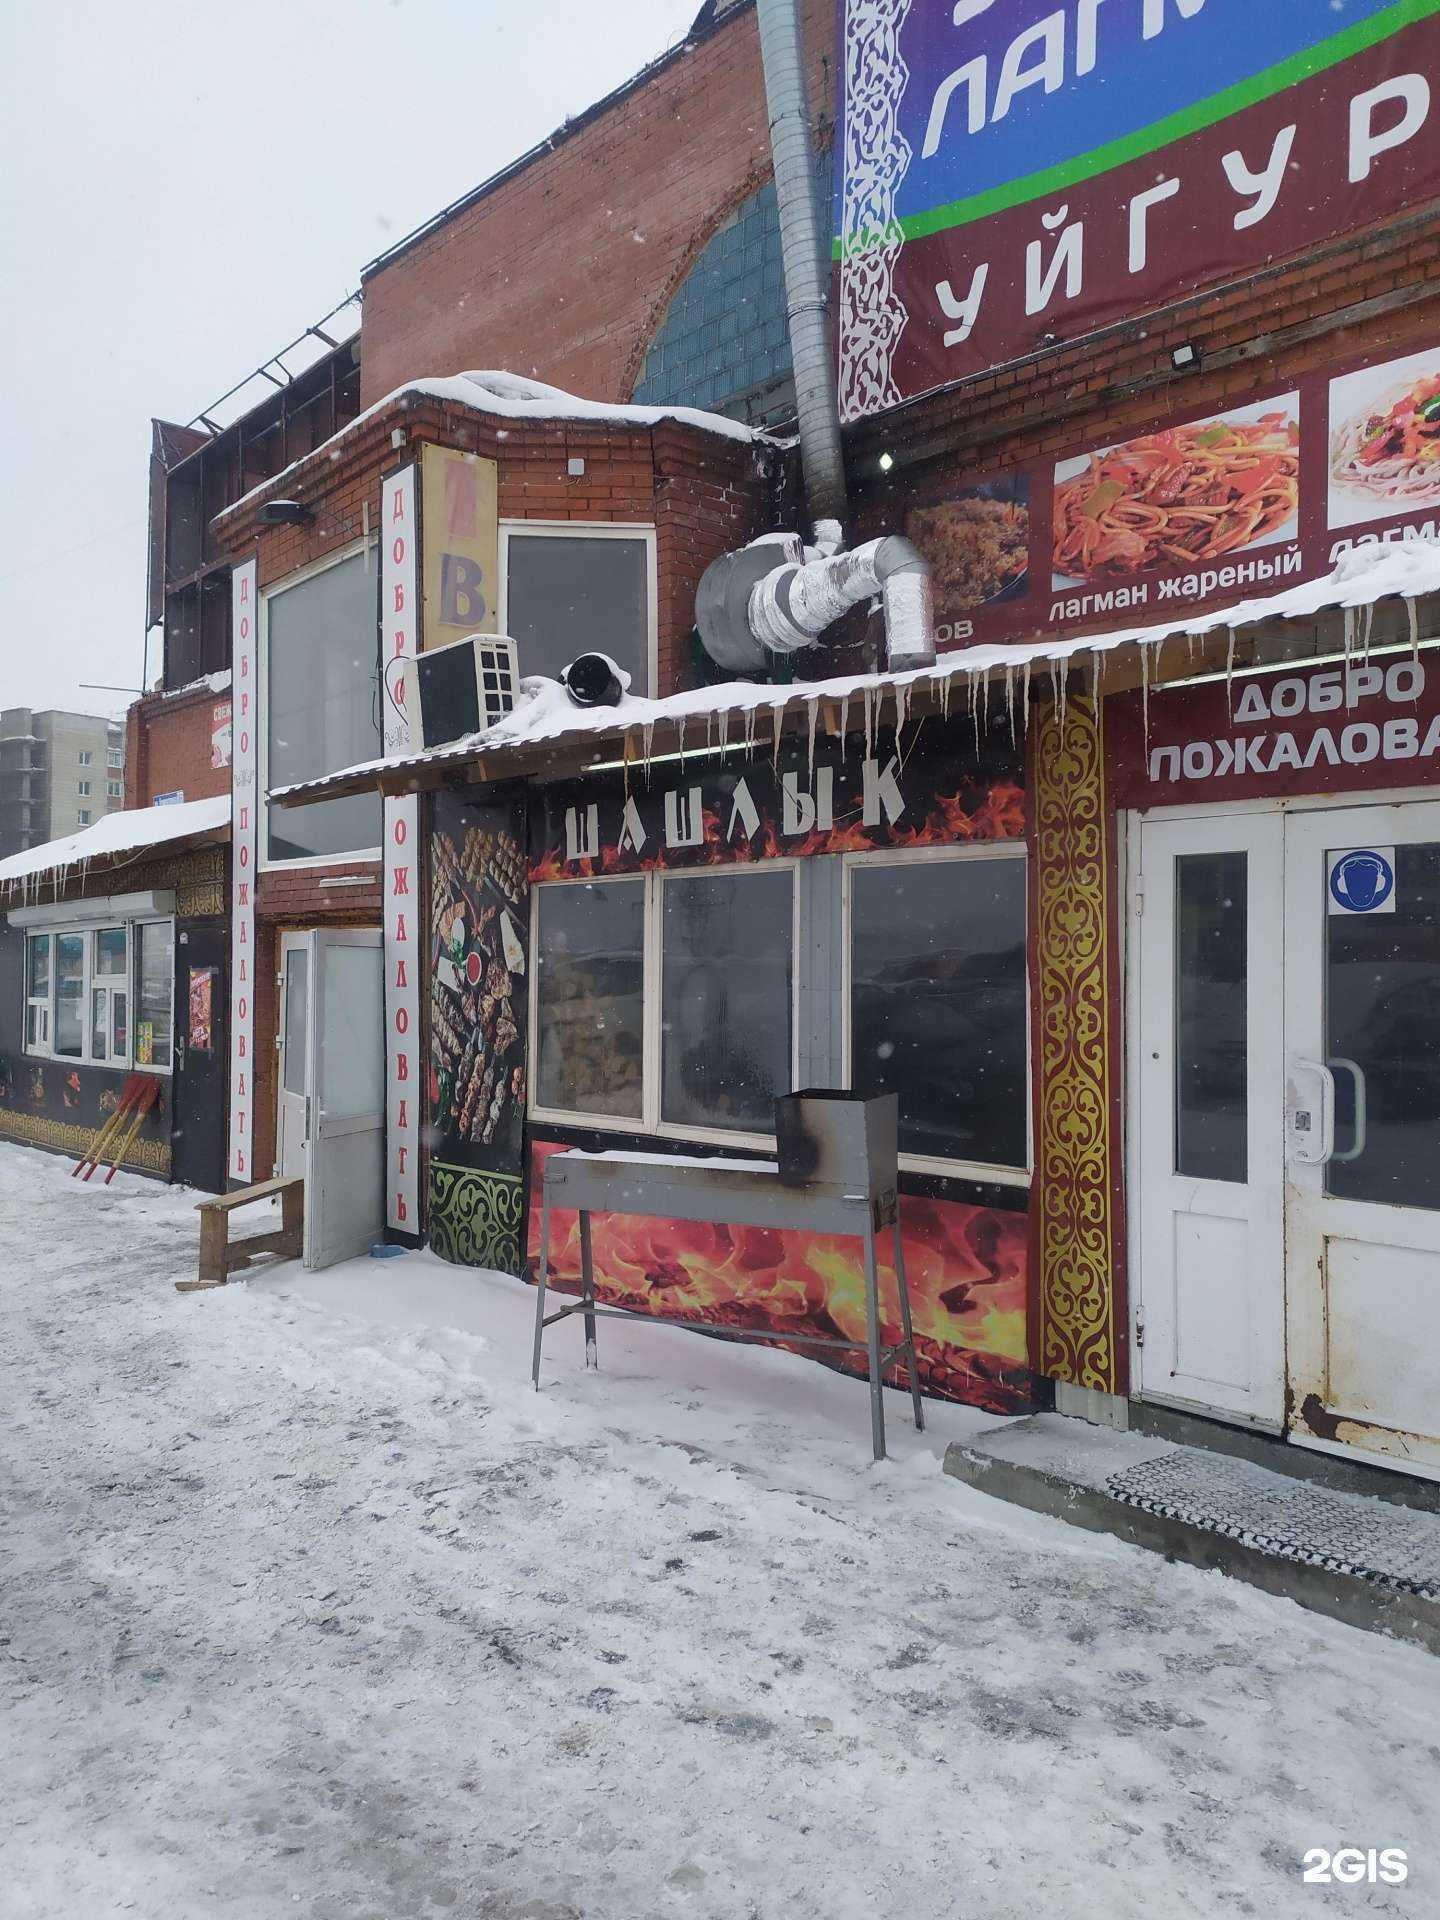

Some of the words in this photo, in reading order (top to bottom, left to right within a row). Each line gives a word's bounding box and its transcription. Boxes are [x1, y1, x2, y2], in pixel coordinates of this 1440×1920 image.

[239, 576, 249, 753] ДОБРО
[392, 488, 406, 706] ДОБРО
[1049, 584, 1147, 621] лагман
[1158, 545, 1302, 599] жареный
[1233, 661, 1425, 723] ДОБРО
[565, 755, 906, 860] ШАШЛЫК
[237, 807, 249, 1173] ПОЖАЛОВАТЬ
[393, 794, 409, 1221] ОЖАЛОВАТЬ
